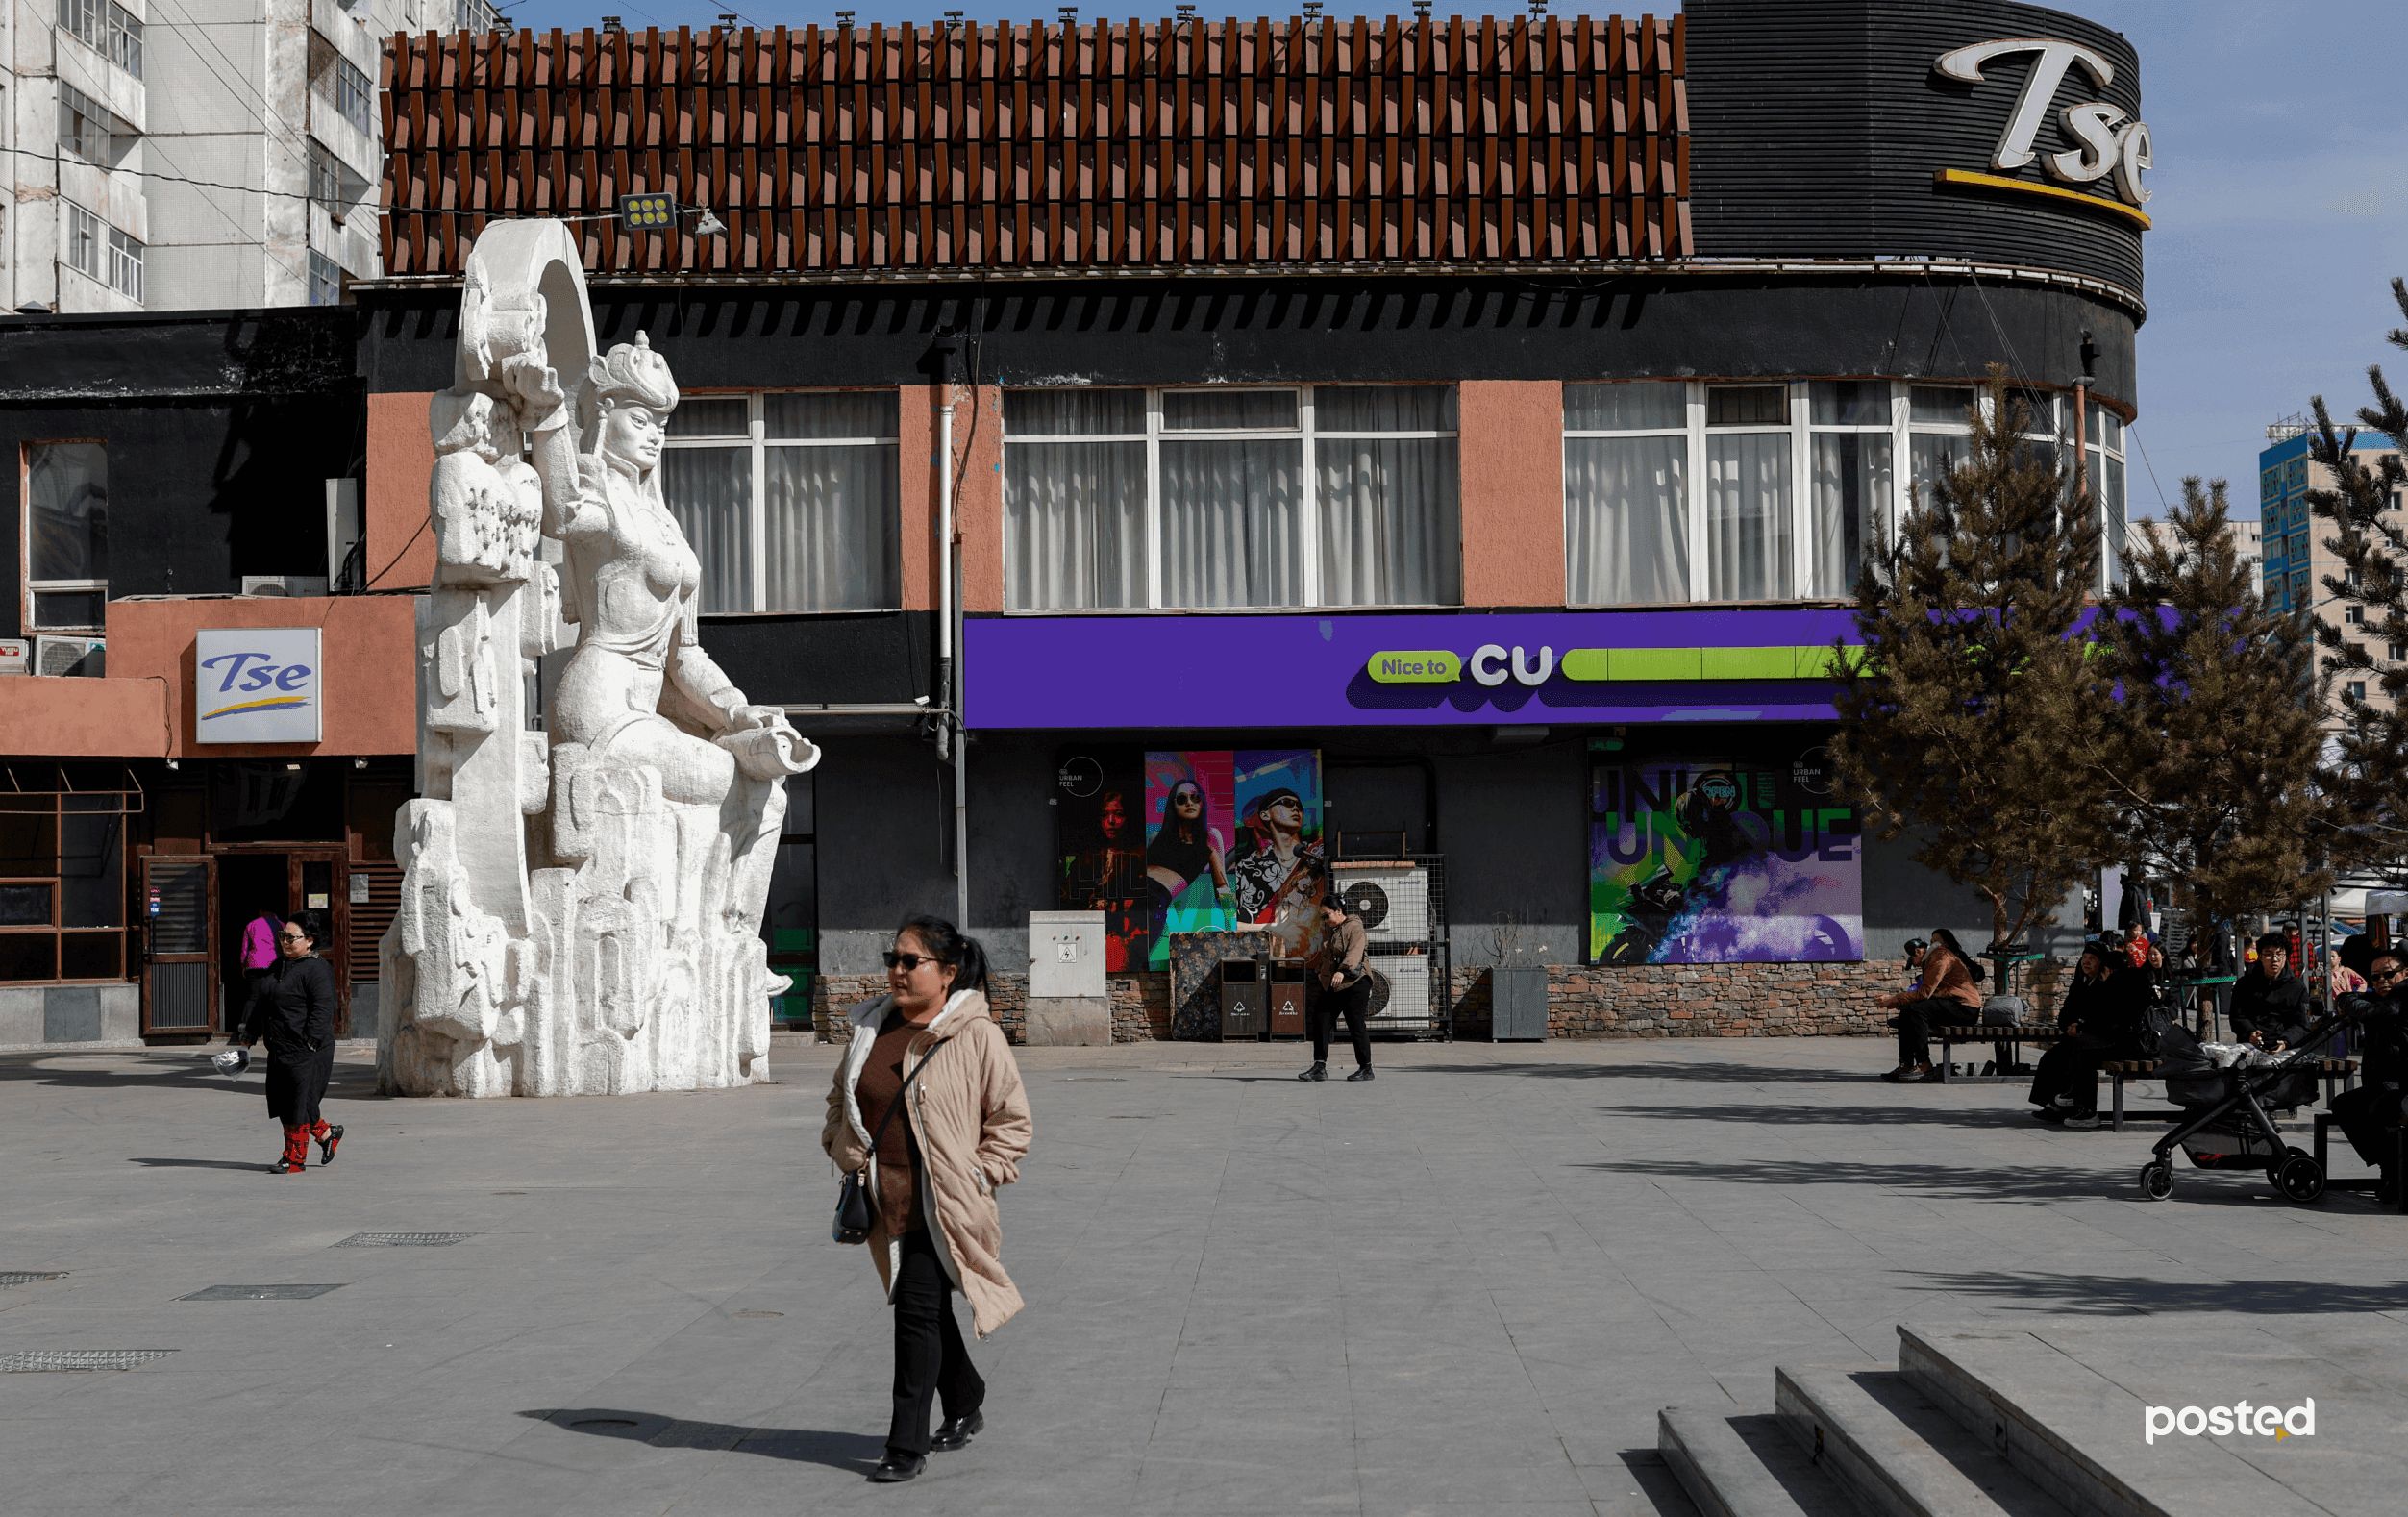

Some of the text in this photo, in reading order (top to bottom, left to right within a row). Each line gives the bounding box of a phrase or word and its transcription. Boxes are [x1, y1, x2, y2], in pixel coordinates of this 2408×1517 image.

[1933, 37, 2154, 204] Tse
[200, 653, 311, 692] Tse
[1381, 644, 1552, 685] Nice to CU
[1702, 785, 1736, 798] OPEN
